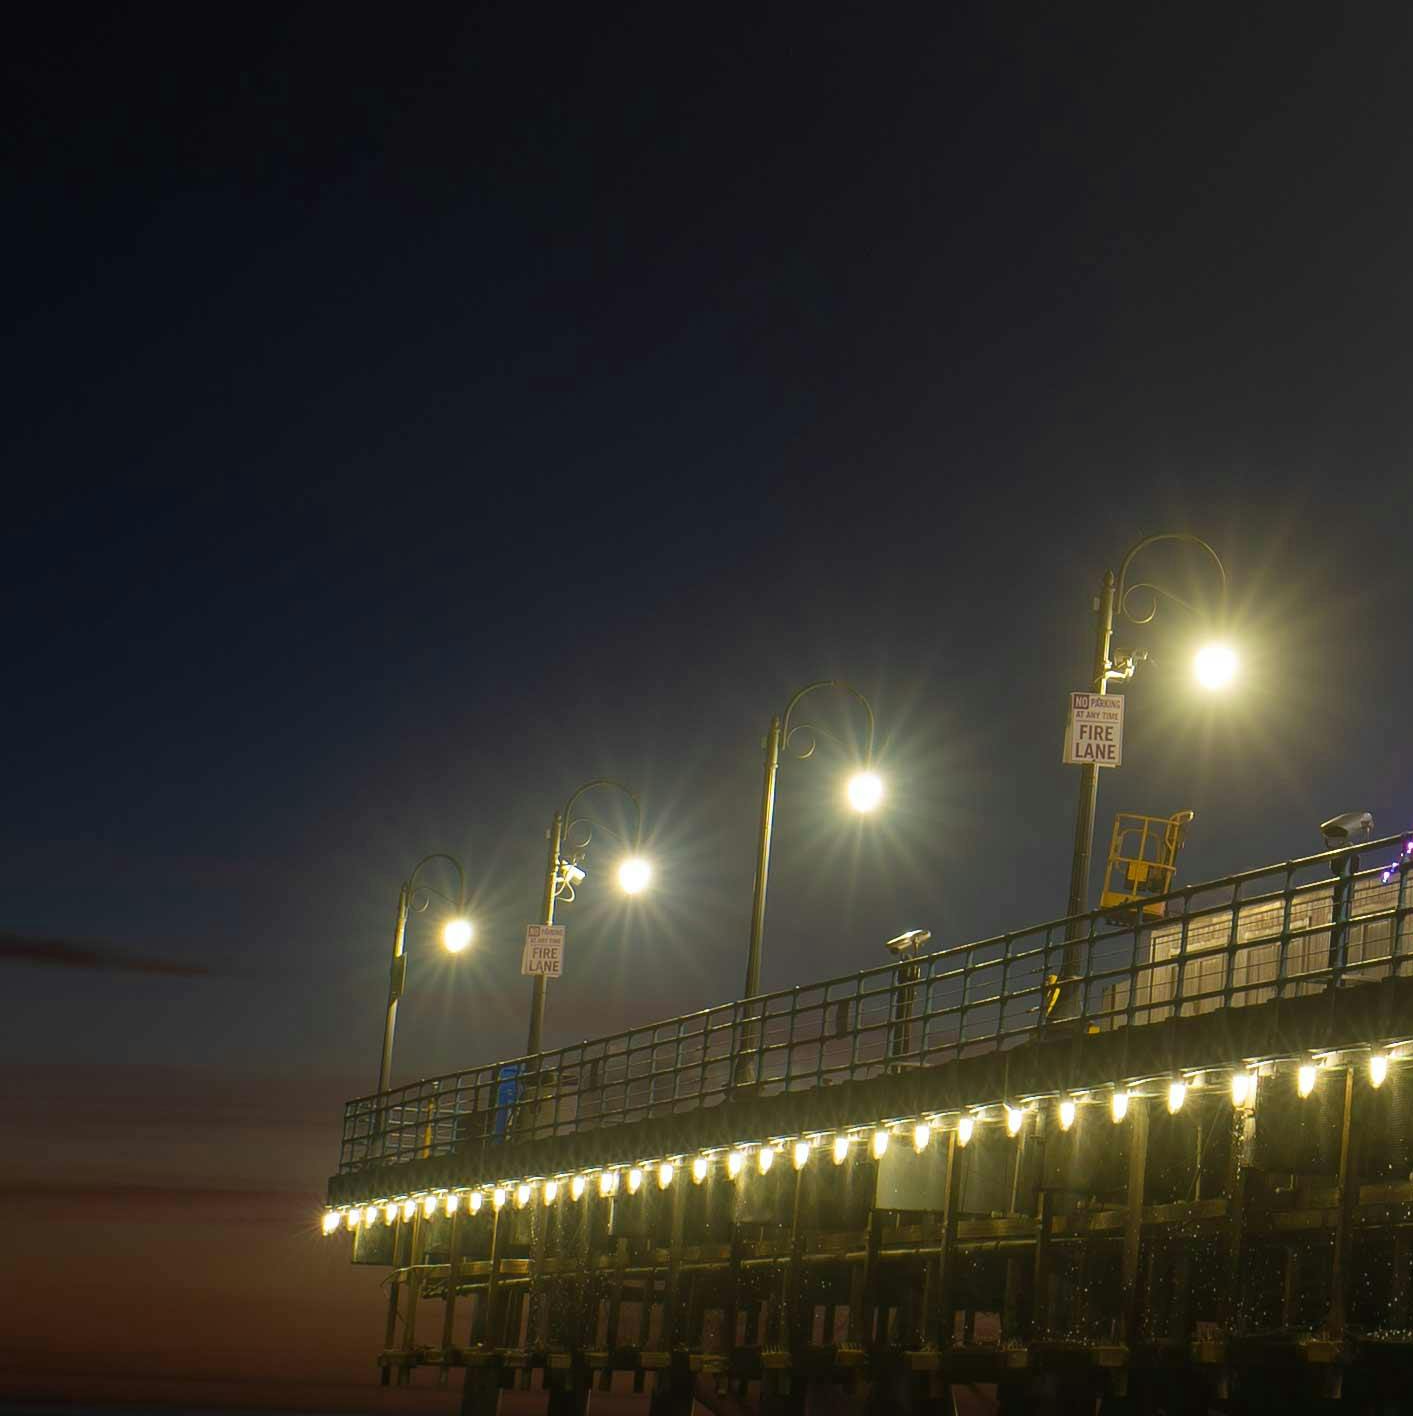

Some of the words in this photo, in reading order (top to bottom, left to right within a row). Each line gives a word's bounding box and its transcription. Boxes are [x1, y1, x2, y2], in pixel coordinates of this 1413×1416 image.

[1075, 695, 1088, 708] NO
[1091, 698, 1121, 709] PARKING
[1076, 710, 1084, 718] AT
[1086, 711, 1101, 719] ANY
[1102, 712, 1119, 720] TIME
[1079, 725, 1114, 742] FIRE
[1075, 743, 1116, 760] LANE
[532, 947, 558, 959] FIRE
[529, 960, 559, 972] LANE
